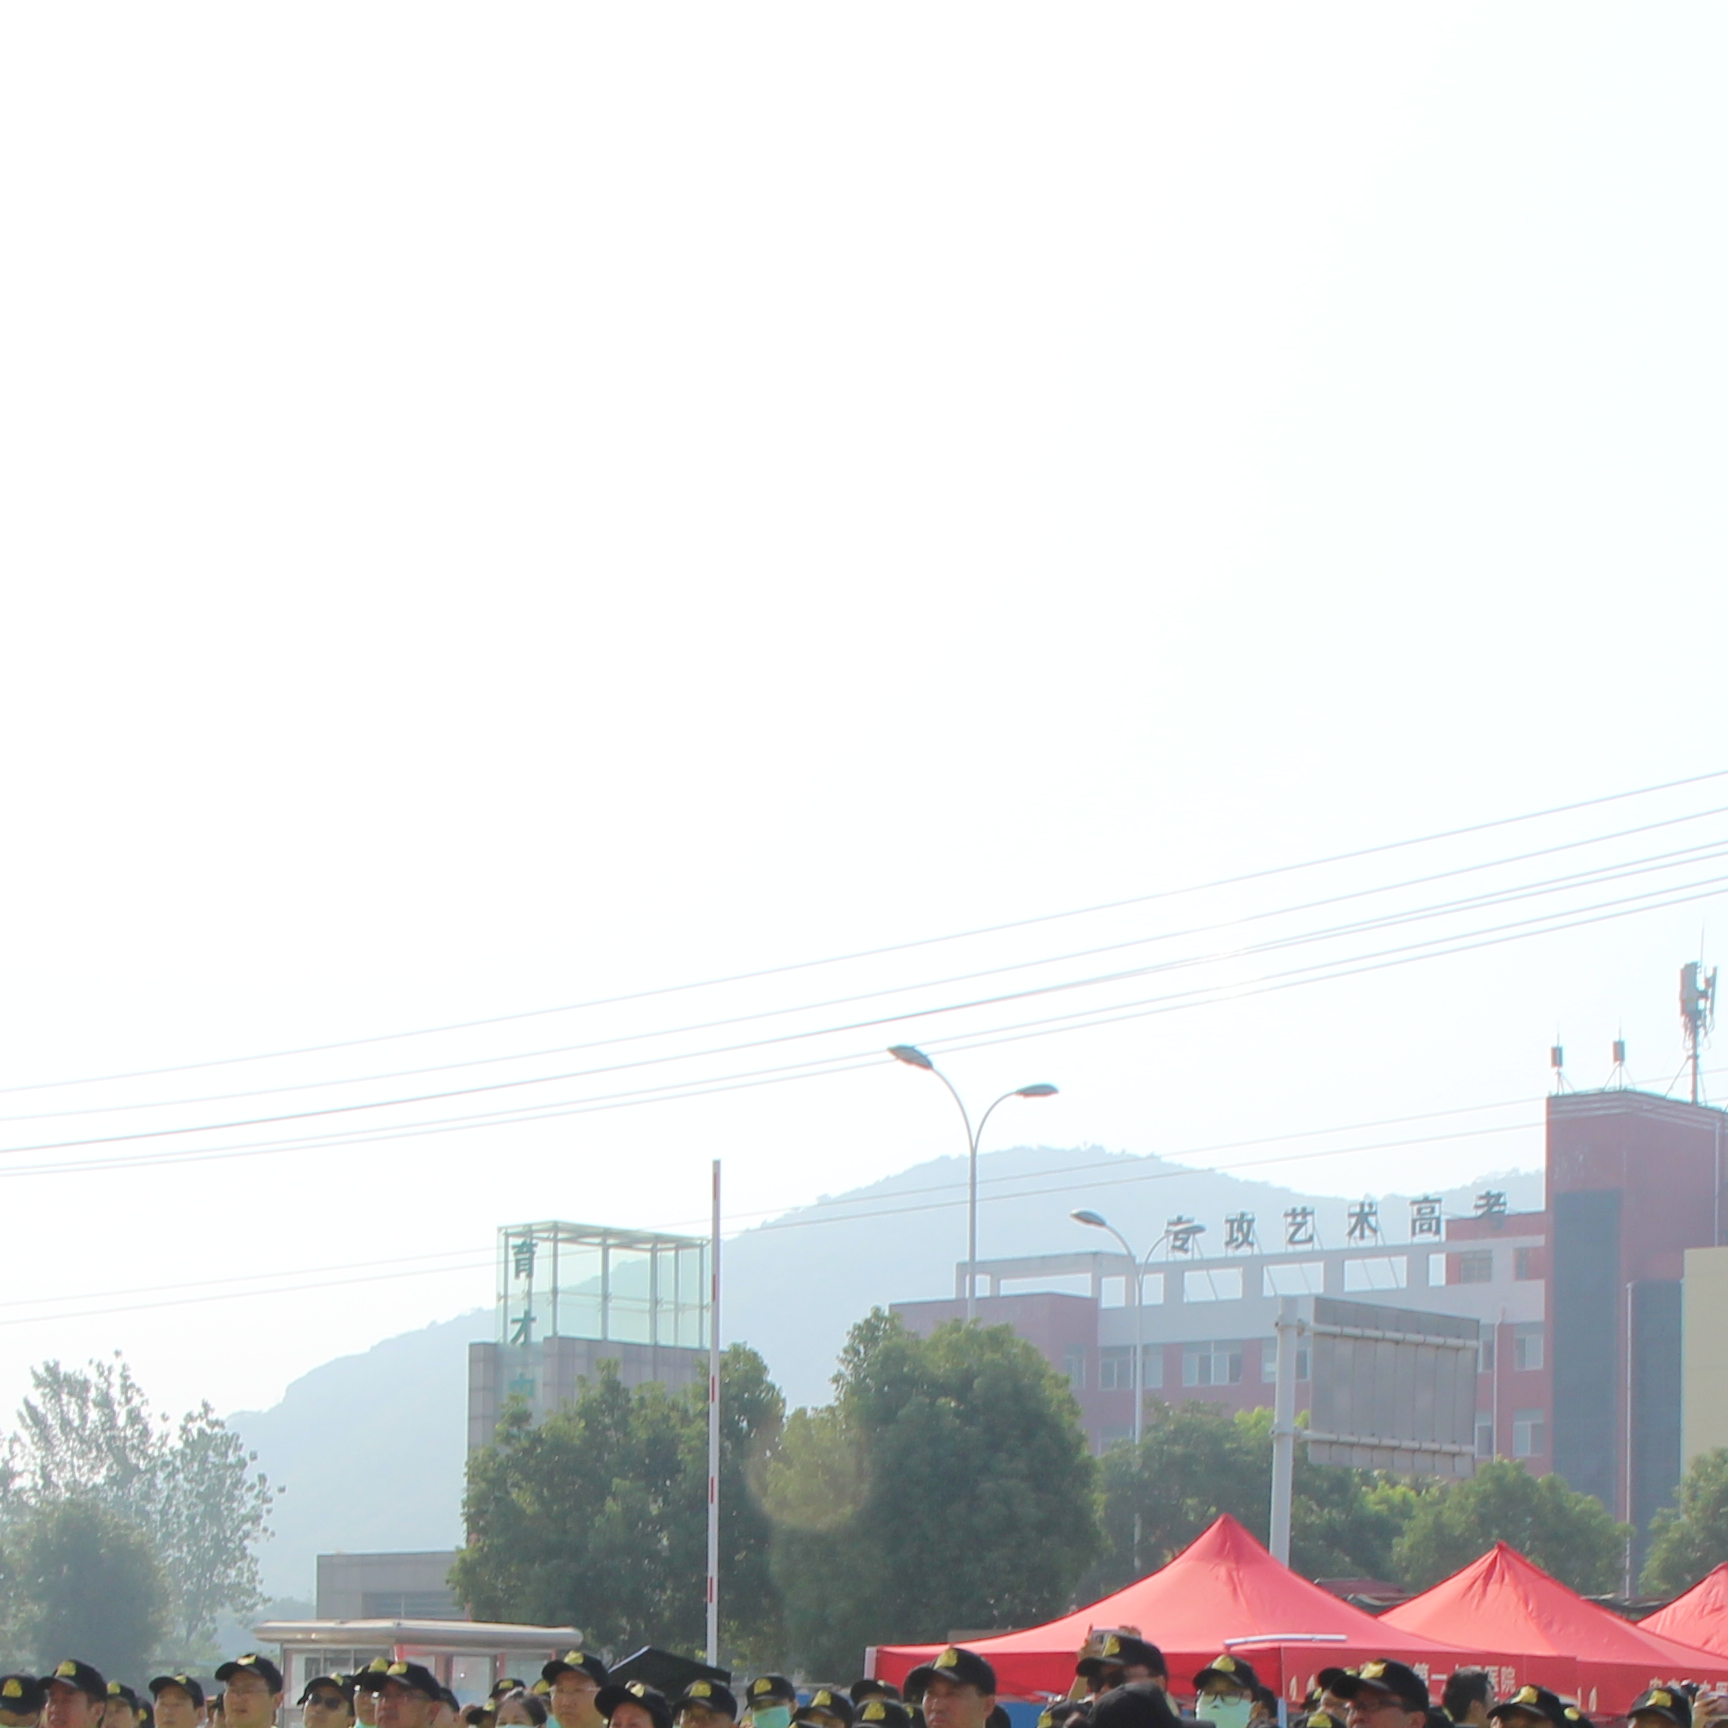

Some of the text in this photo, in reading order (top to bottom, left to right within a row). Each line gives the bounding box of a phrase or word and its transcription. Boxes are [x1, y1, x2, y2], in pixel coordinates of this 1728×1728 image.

[1166, 1190, 1508, 1253] 专攻艺术高考
